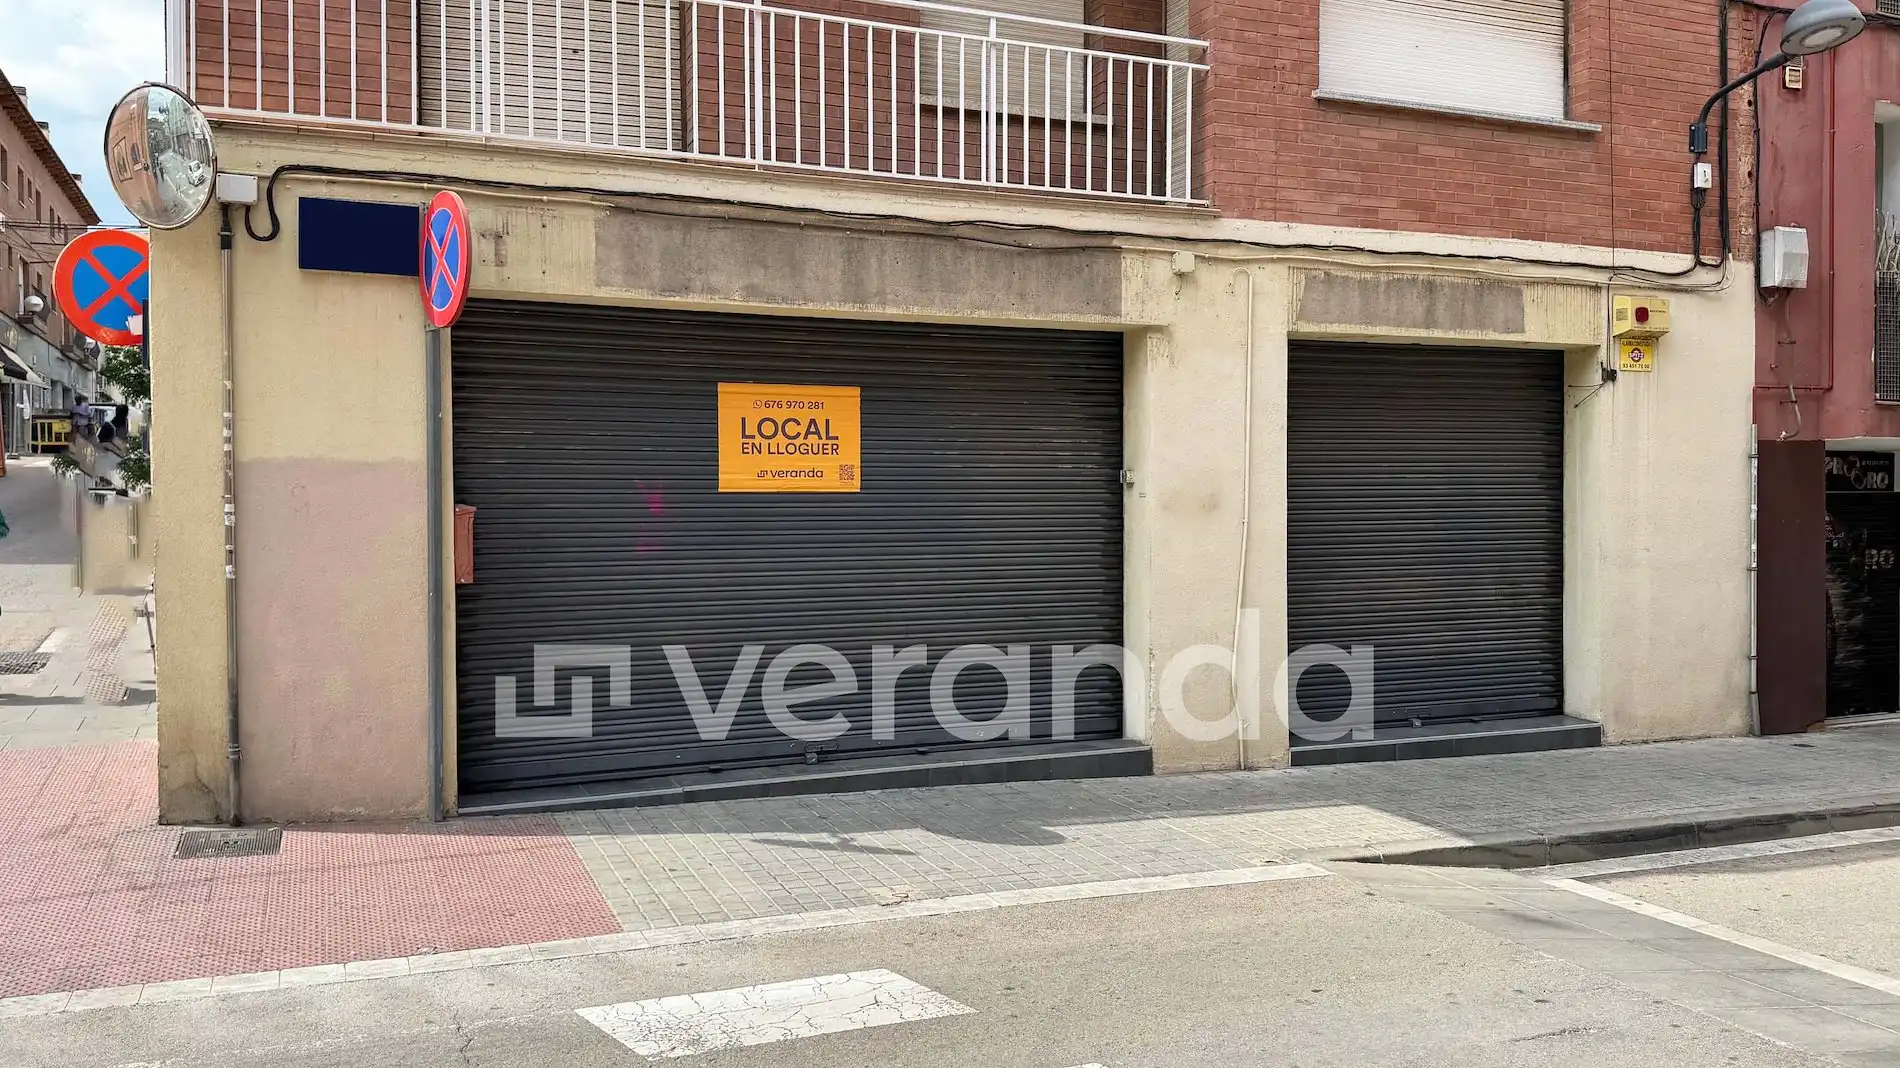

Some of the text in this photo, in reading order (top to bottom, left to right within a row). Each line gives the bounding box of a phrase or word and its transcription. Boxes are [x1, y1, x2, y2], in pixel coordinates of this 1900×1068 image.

[764, 400, 824, 410] 676 970 281
[741, 417, 839, 440] LOCAL
[742, 442, 839, 456] EN LLOGUER
[771, 467, 824, 479] veranda
